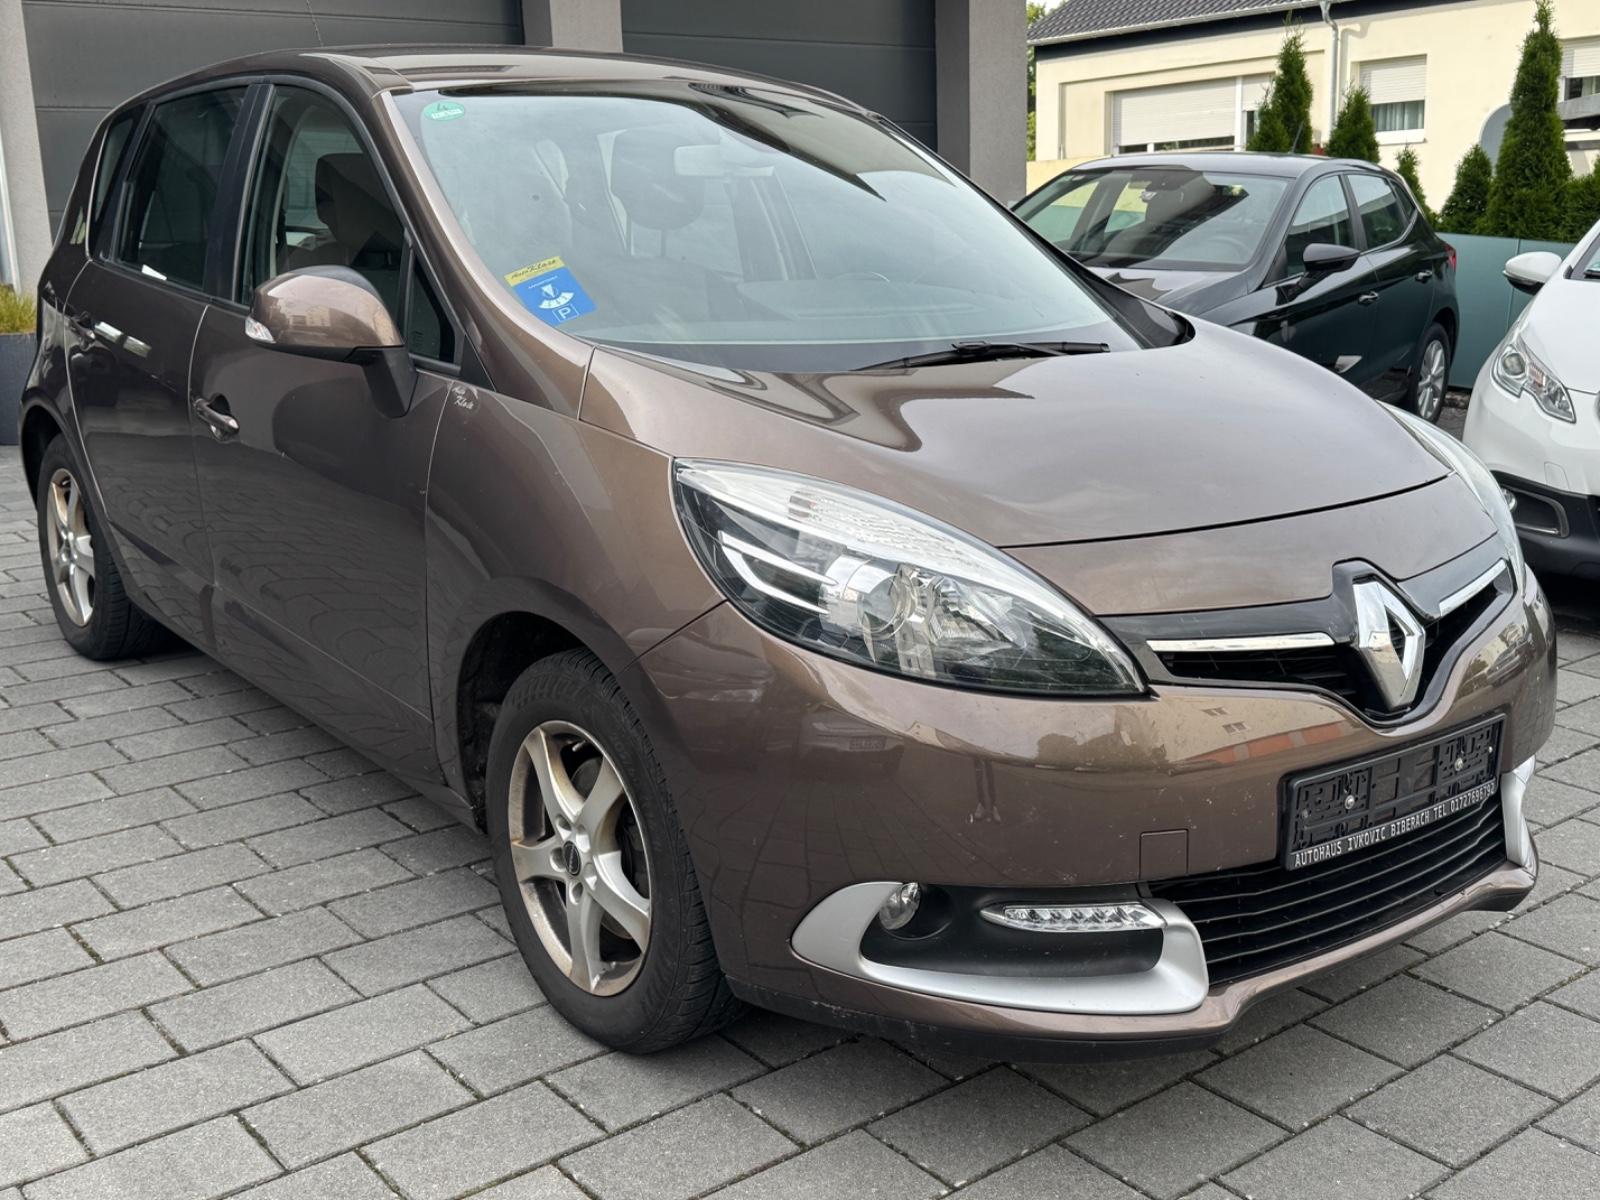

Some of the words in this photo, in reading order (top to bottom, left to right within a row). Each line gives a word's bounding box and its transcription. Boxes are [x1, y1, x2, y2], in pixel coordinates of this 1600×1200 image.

[558, 307, 571, 319] P
[1294, 841, 1342, 868] AUTOHAUS
[1347, 827, 1386, 852] IVKOVIC
[1390, 810, 1430, 837] BIBERACH
[1433, 803, 1447, 820] TEL
